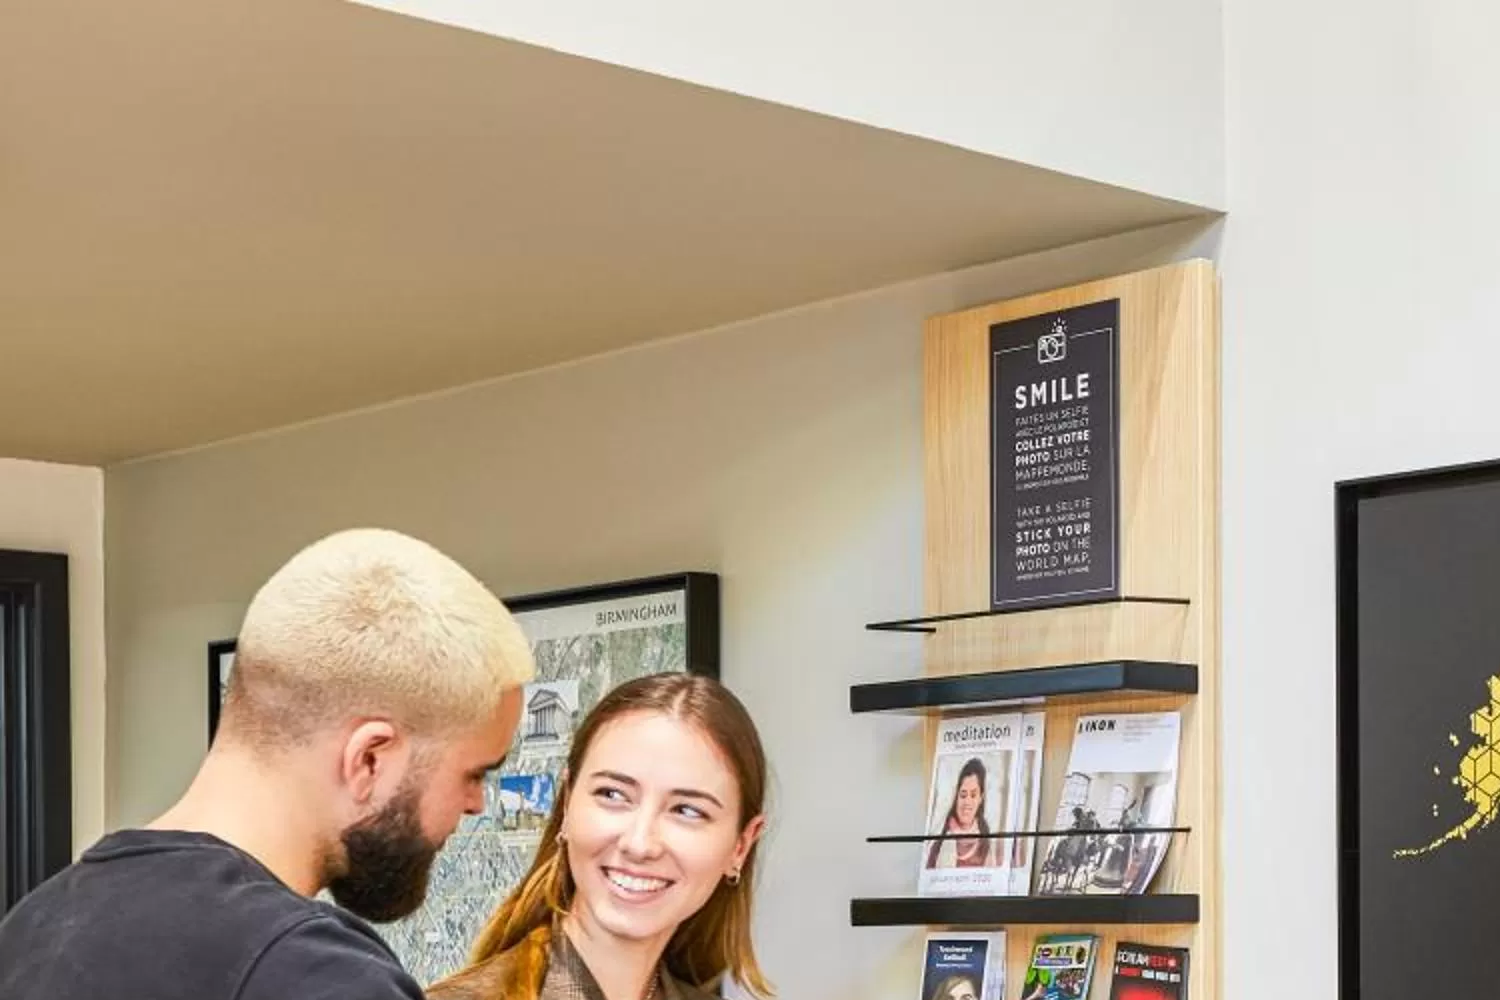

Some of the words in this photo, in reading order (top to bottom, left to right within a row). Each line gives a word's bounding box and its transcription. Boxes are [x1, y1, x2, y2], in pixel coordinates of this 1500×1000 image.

[1015, 373, 1089, 409] SMILE
[1015, 435, 1054, 453] COLLEZ
[1057, 429, 1091, 445] VOTRE
[1015, 451, 1051, 467] PHOTO
[1053, 447, 1074, 461] SUR
[1076, 443, 1091, 457] LA
[1016, 505, 1041, 519] TAKE
[1045, 504, 1052, 513] A
[1055, 497, 1092, 513] SELFIE
[1015, 527, 1052, 543] STICK
[1057, 521, 1091, 537] YOUR
[1015, 543, 1051, 558] PHOTO
[1053, 540, 1069, 553] ON
[1071, 535, 1091, 550] THE
[1015, 555, 1059, 572] WORLD
[595, 602, 677, 627] BIRMINGHAM
[943, 723, 1011, 742] meditation
